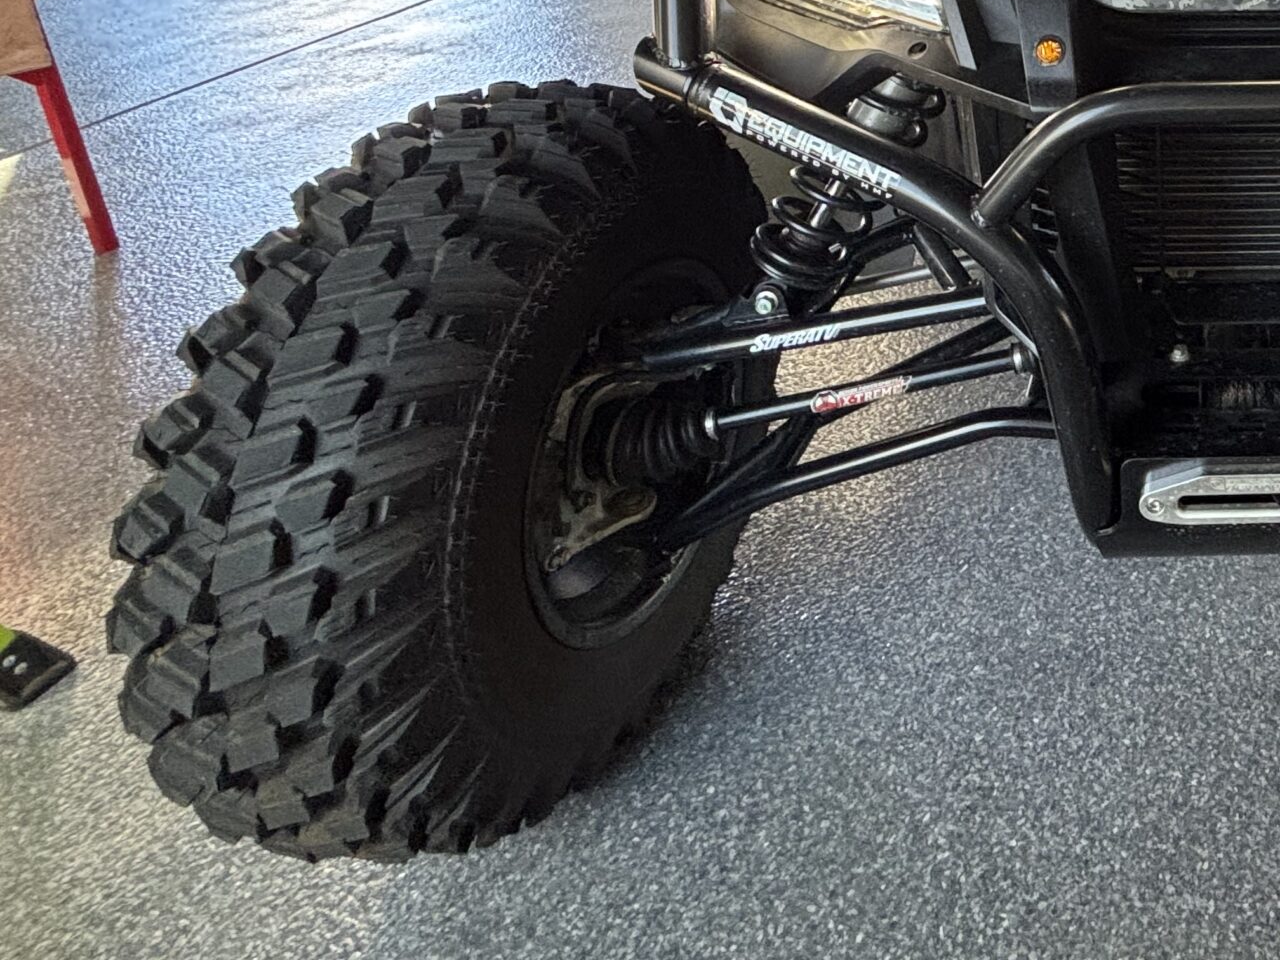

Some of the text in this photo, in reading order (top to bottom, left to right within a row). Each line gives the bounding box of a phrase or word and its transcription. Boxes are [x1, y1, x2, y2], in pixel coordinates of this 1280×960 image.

[746, 130, 822, 168] POWERED
[832, 169, 852, 181] BY
[747, 107, 901, 191] EQUIPMENT
